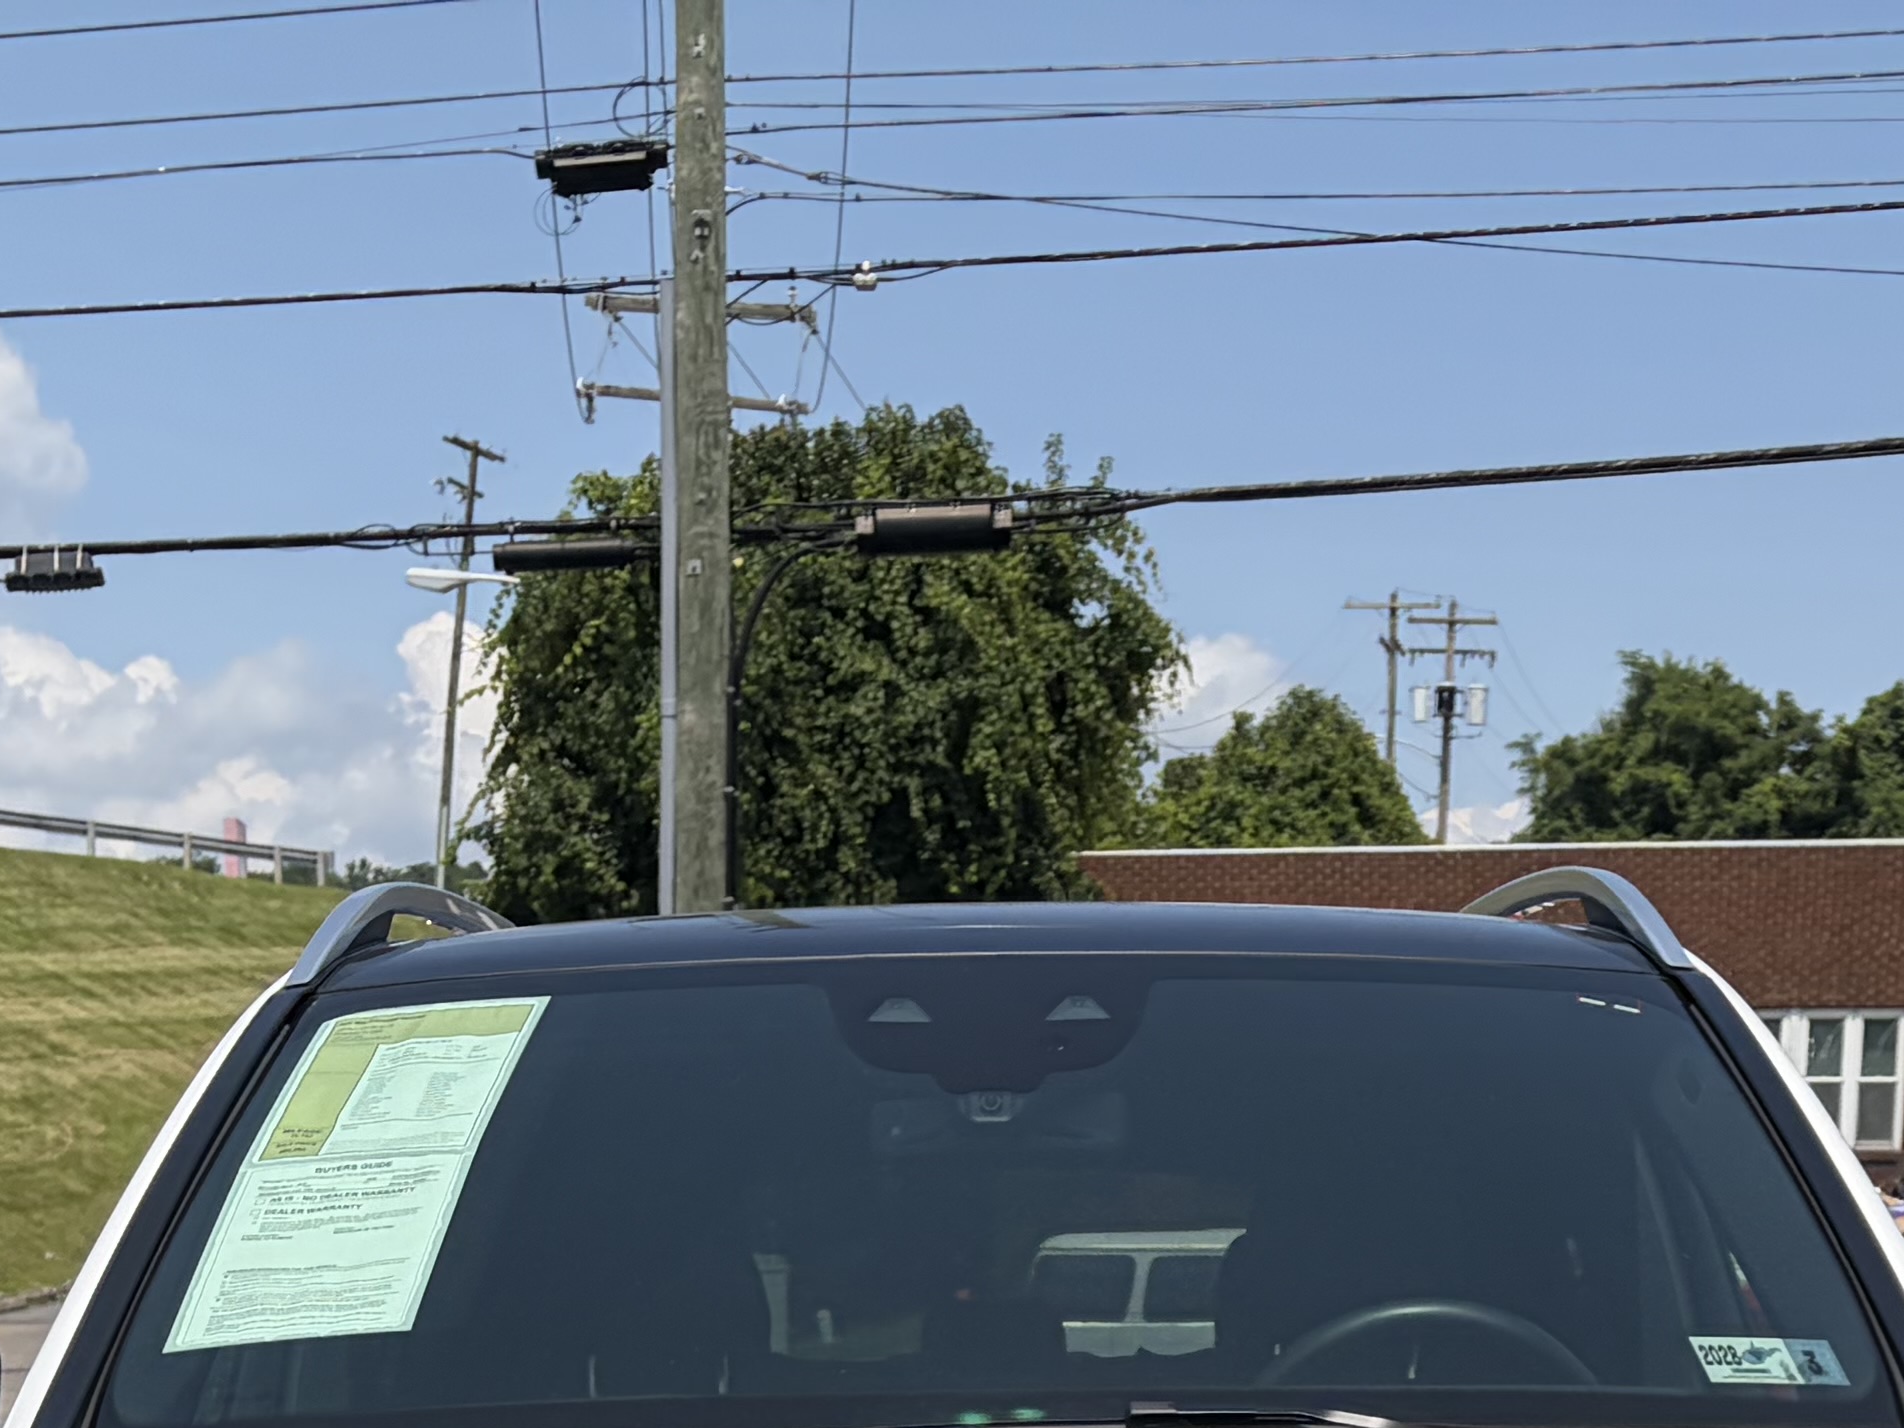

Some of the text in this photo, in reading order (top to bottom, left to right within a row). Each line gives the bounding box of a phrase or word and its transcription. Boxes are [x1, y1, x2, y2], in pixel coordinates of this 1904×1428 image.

[315, 1160, 394, 1174] BUYERS GUIDE
[319, 1191, 359, 1200] DEALER
[361, 1186, 417, 1197] WARRANTY
[264, 1203, 364, 1216] DEALER WARRANTY
